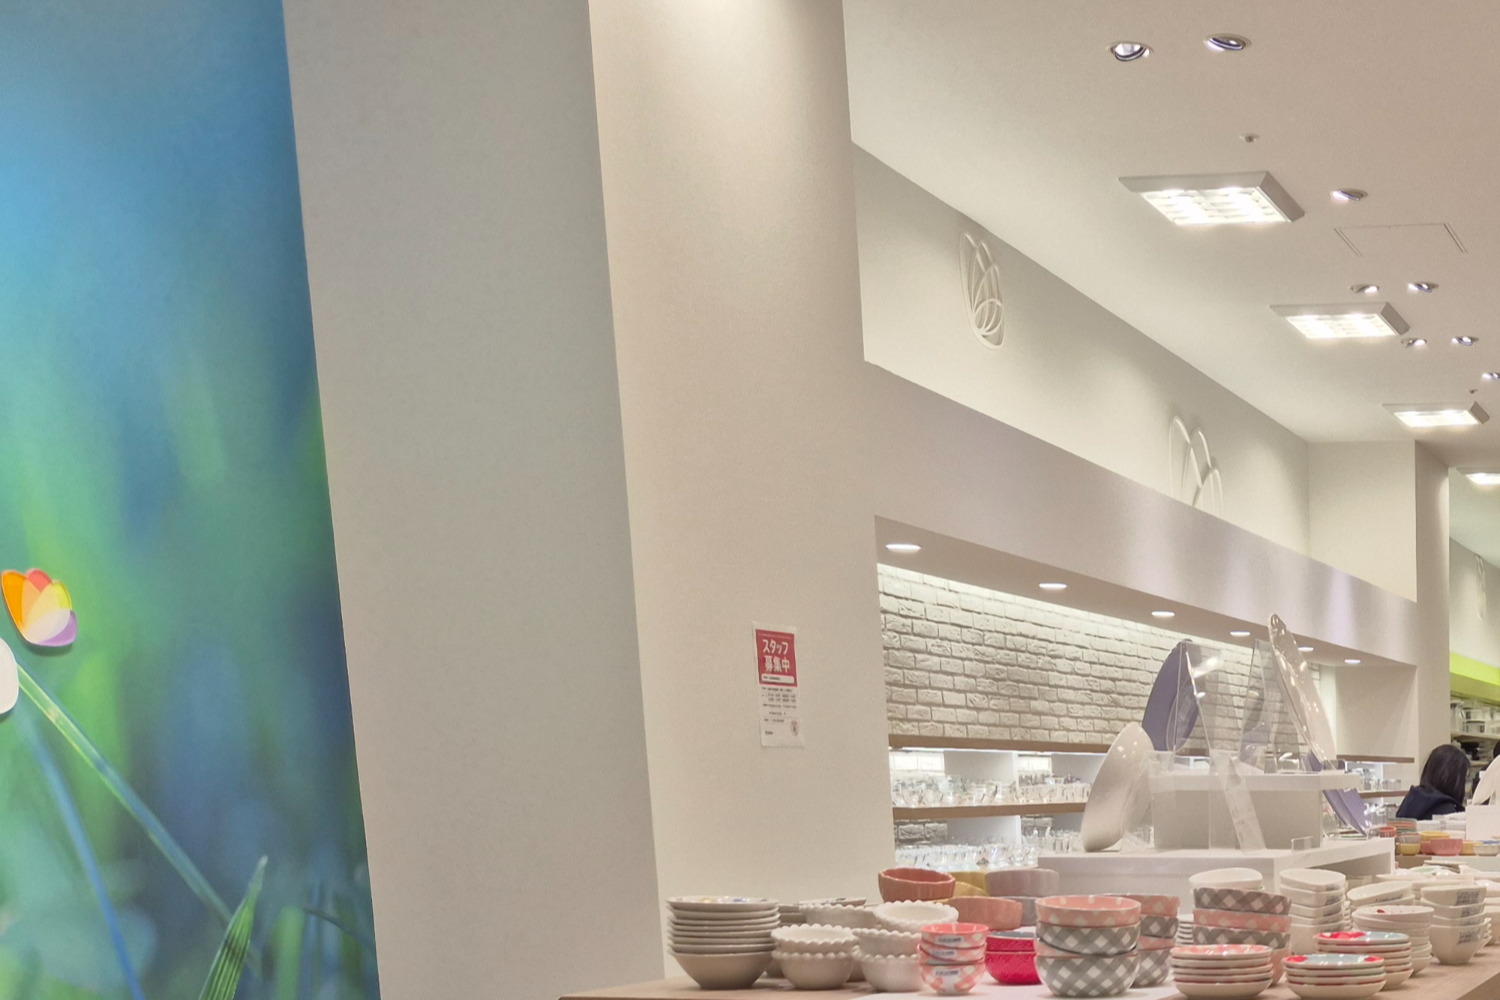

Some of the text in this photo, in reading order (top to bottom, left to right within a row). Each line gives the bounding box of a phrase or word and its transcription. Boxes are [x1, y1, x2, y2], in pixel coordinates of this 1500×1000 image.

[762, 639, 789, 655] スタッフ
[764, 656, 790, 673] 募集中
